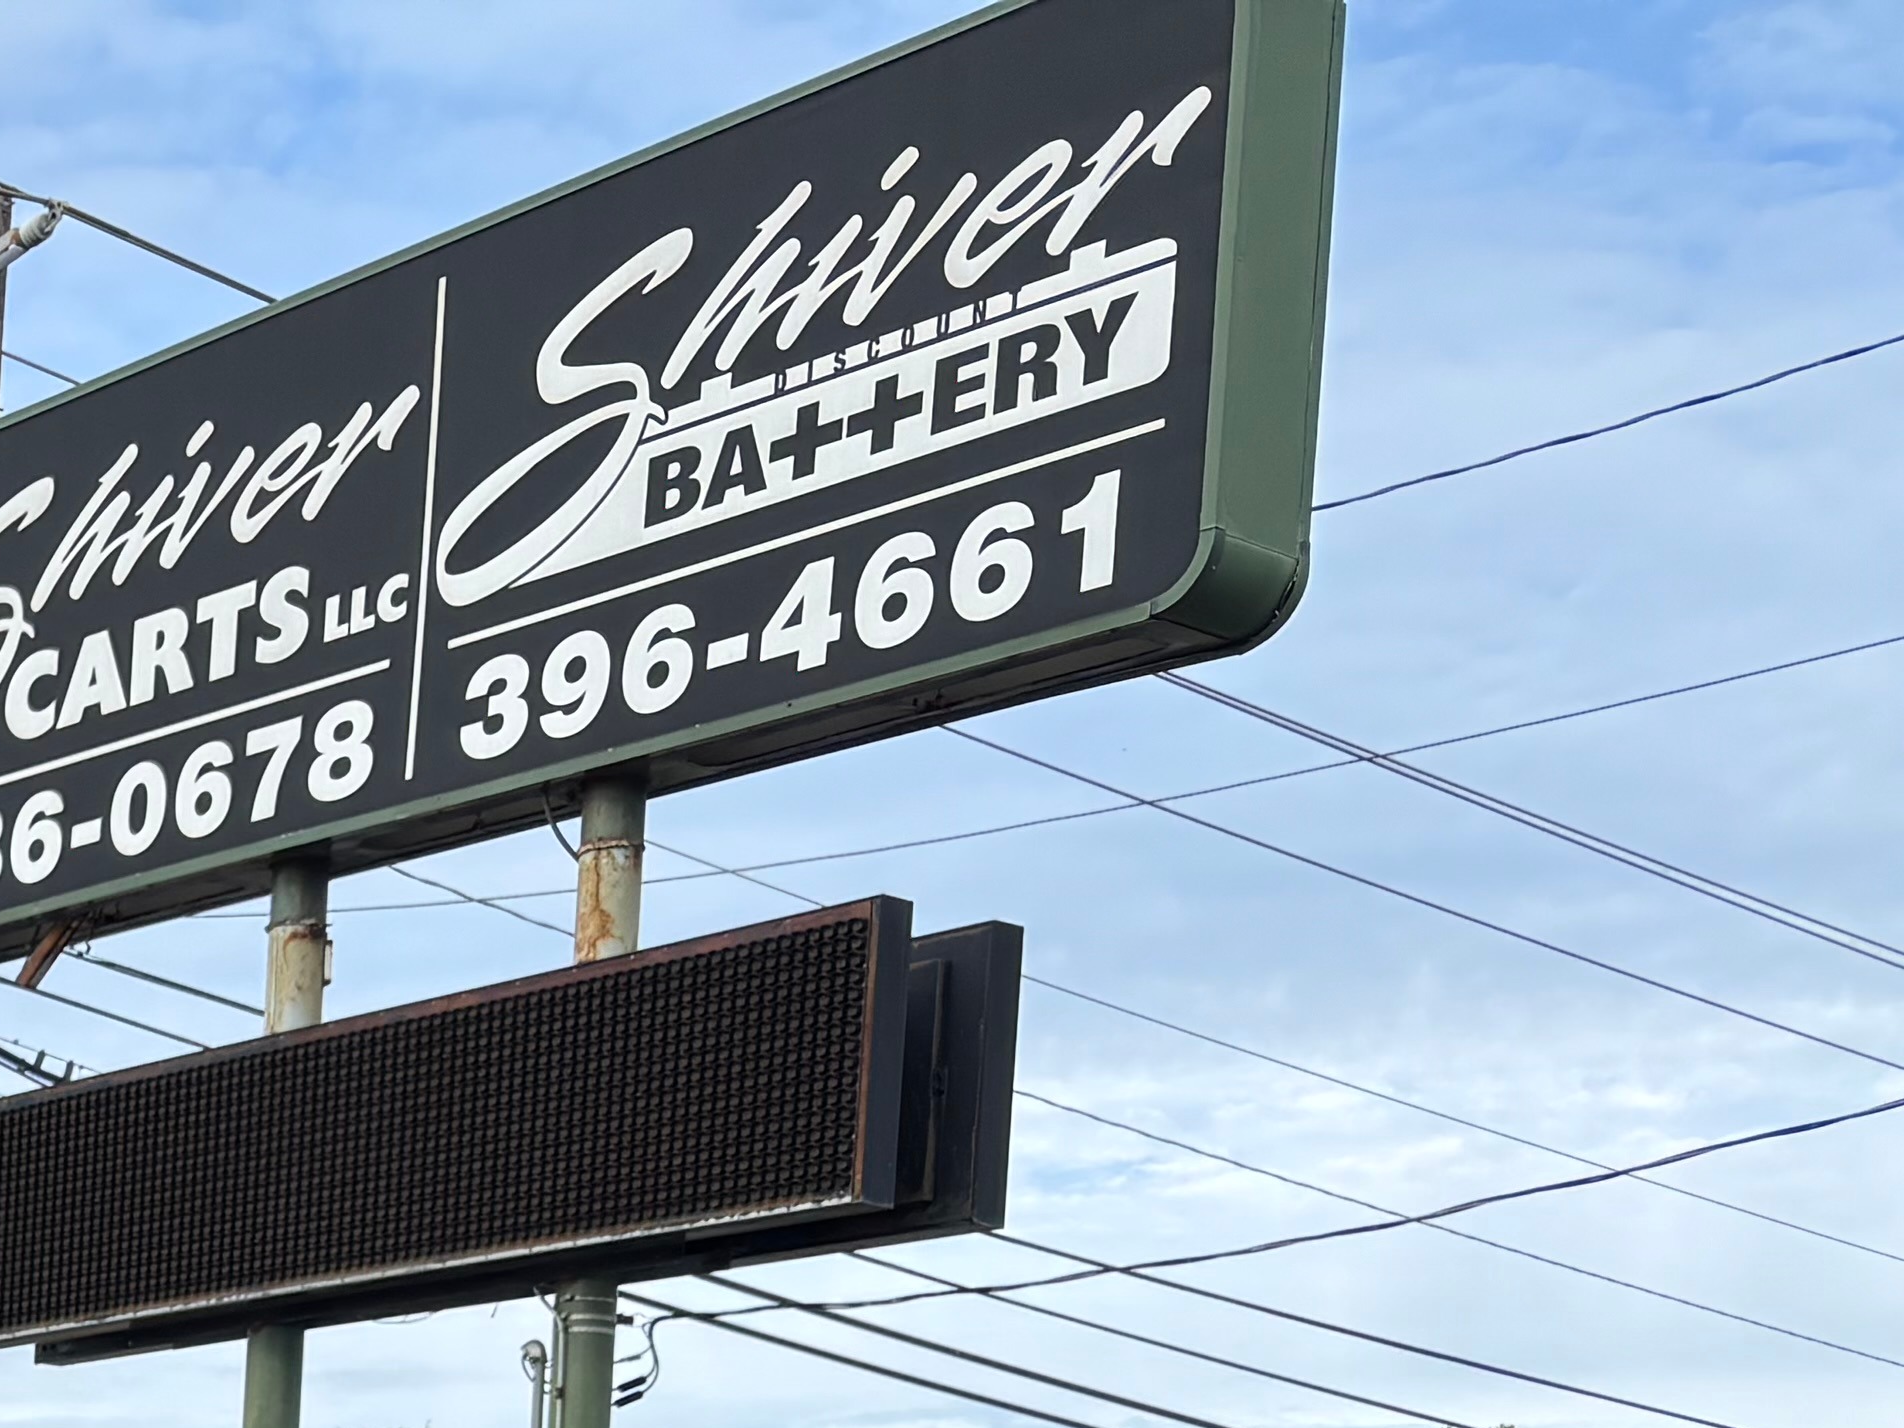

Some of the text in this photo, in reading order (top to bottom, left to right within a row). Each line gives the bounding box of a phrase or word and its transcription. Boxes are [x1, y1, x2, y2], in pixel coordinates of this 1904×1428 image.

[435, 85, 1213, 607] Shiver
[4, 565, 410, 740] CARTS LLC
[458, 468, 1122, 760] 396-4661
